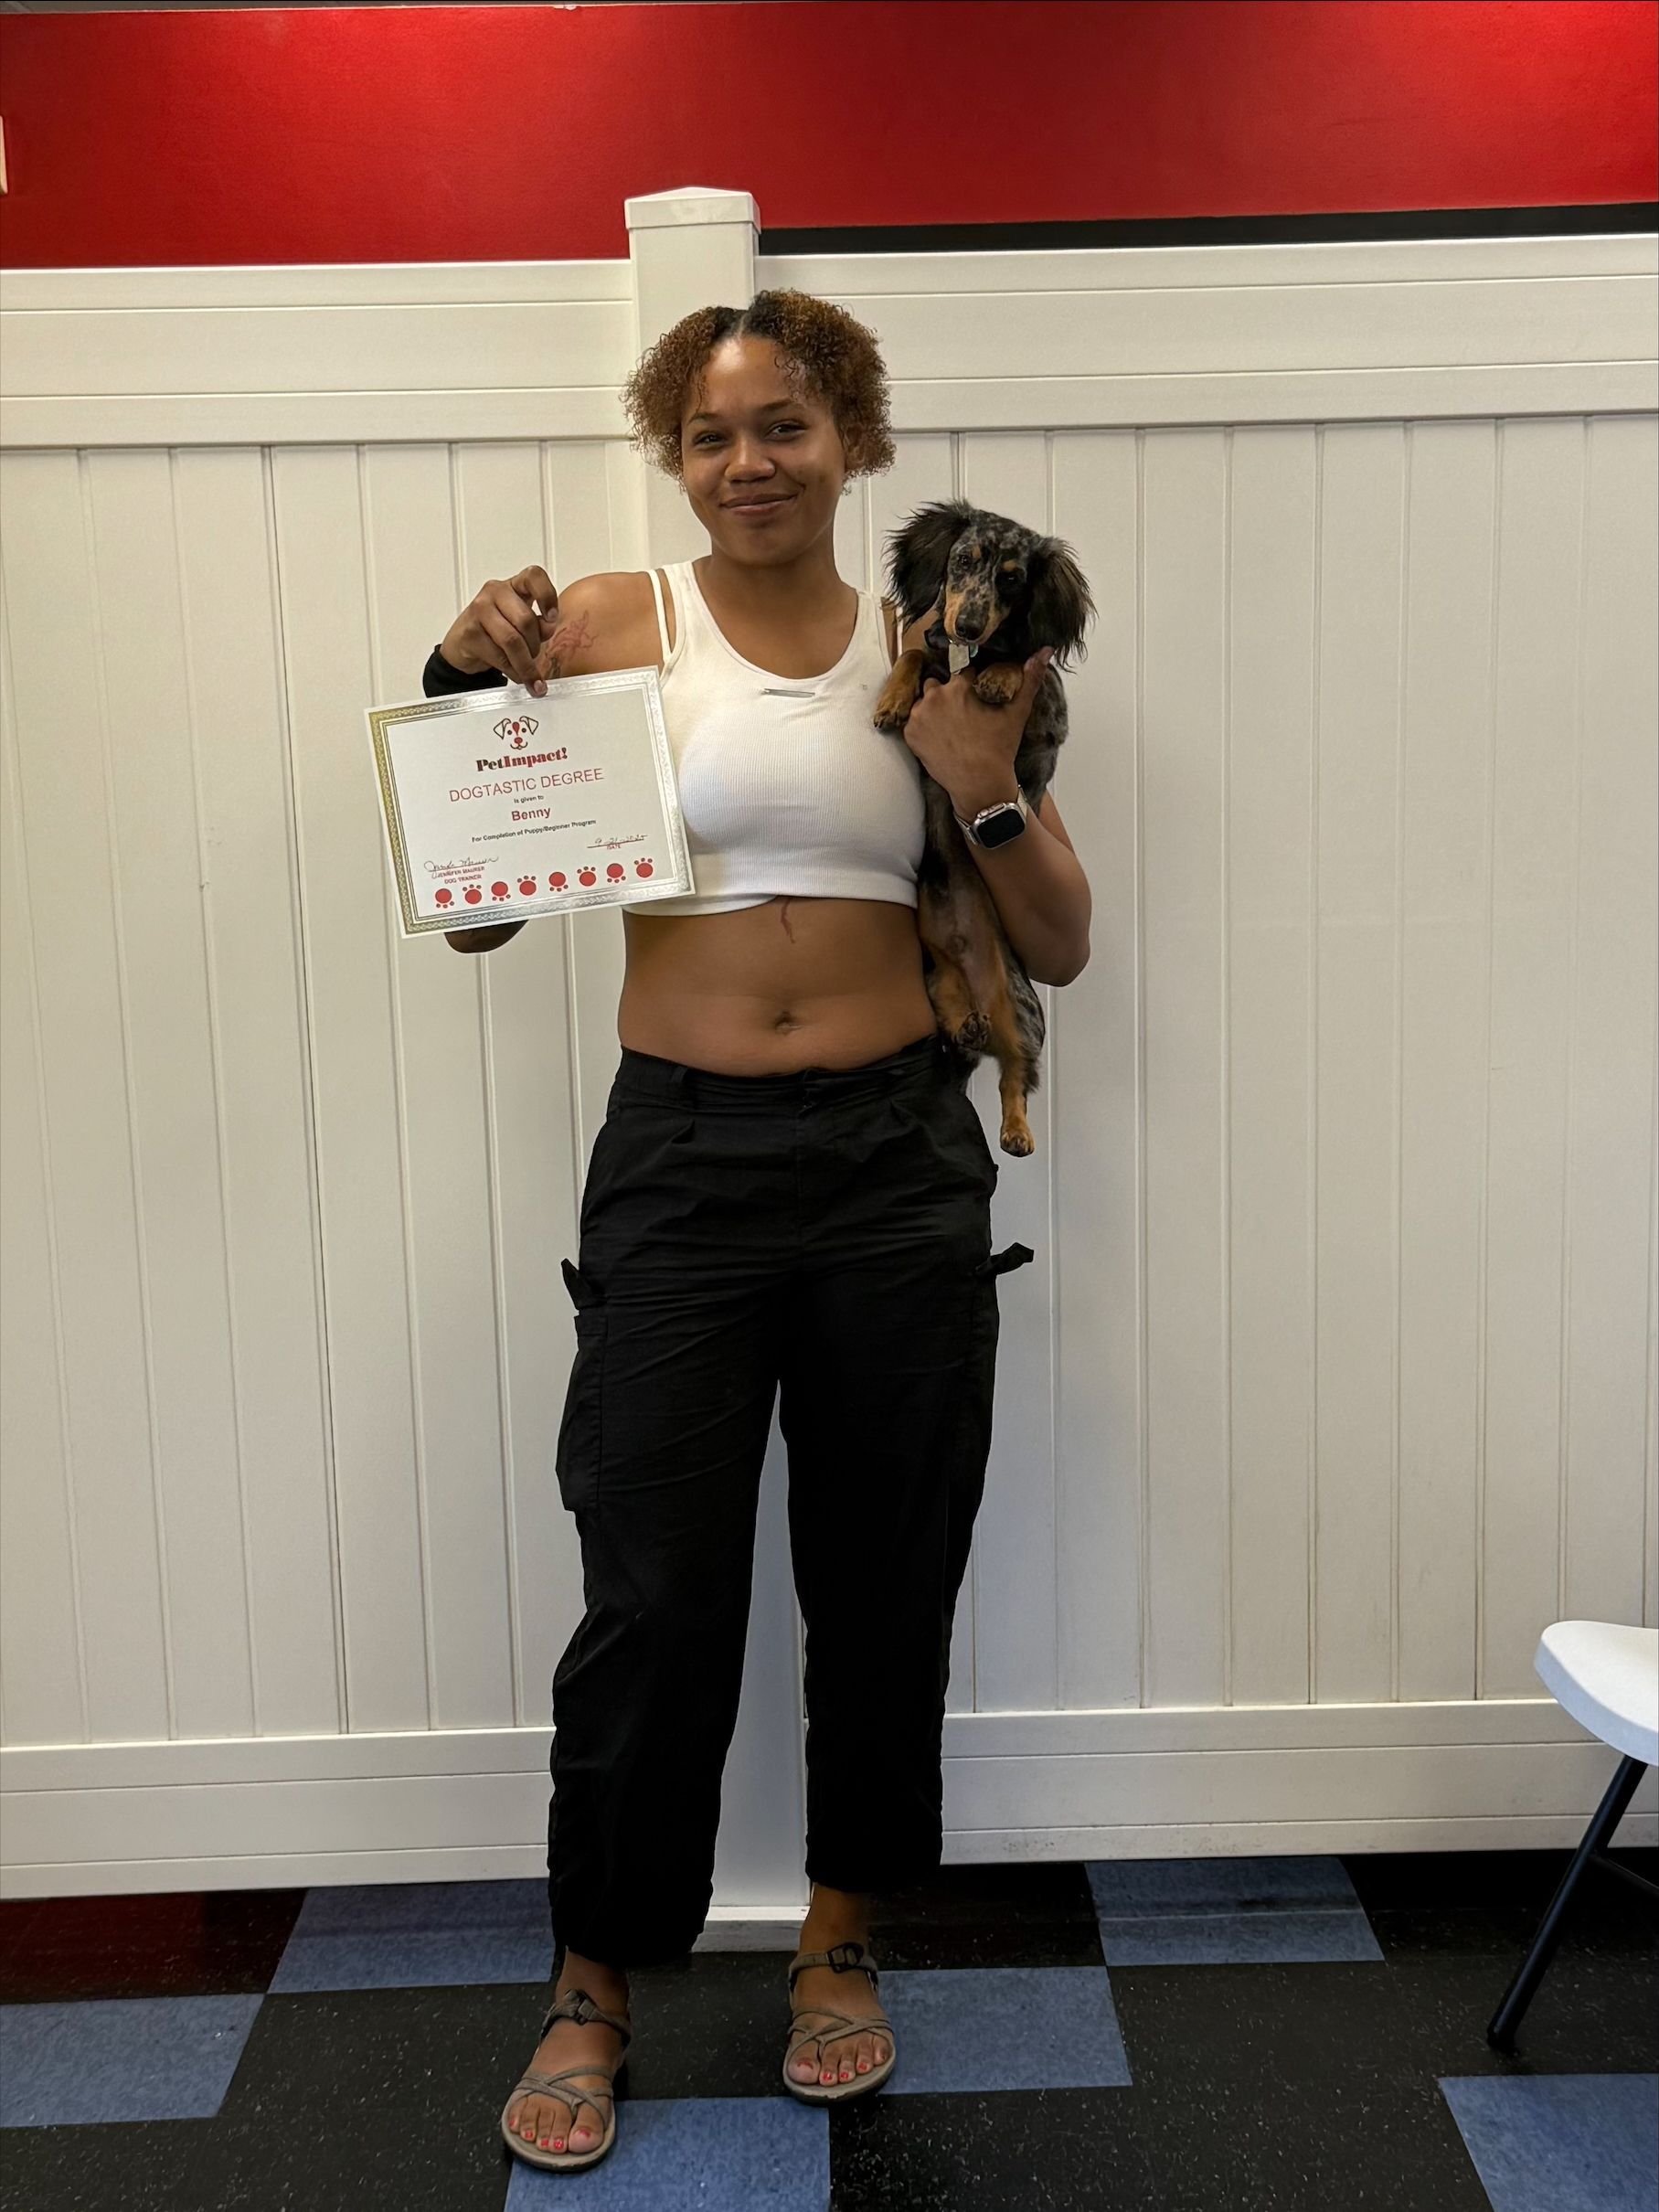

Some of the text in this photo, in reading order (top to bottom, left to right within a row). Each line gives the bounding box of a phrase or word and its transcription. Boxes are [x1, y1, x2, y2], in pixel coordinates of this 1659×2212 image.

[476, 747, 568, 771] PetImpact!
[450, 768, 604, 802] DOGTASTIC DEGREE
[512, 807, 550, 821] Benny
[484, 831, 516, 840] Completion
[525, 824, 570, 834] Puppy/Beginner
[571, 819, 596, 827] Program
[458, 874, 482, 882] TRAINER
